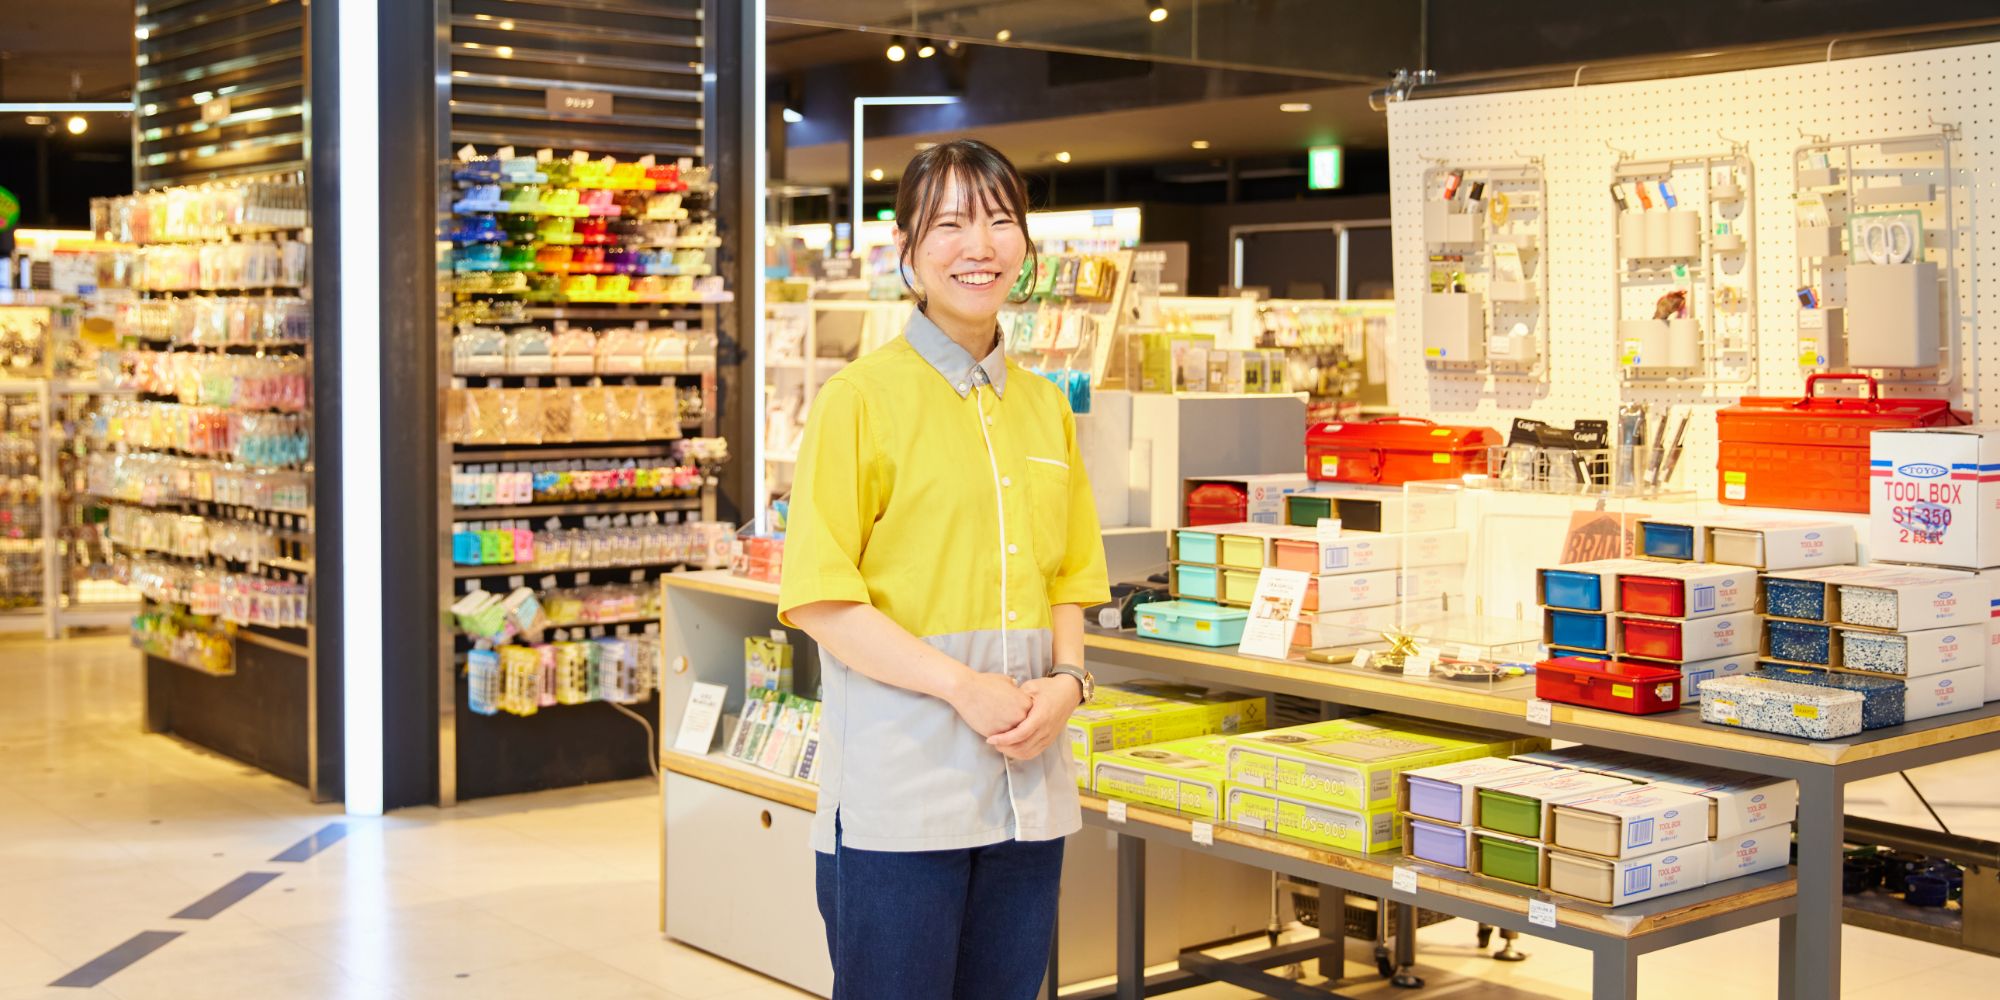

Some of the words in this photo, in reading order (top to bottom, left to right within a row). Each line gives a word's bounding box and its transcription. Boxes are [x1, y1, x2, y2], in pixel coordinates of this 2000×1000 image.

[1909, 467, 1939, 476] TOYO
[1884, 481, 1925, 502] TOOL
[1929, 483, 1962, 505] BOX
[1892, 506, 1952, 526] ST-350
[1301, 815, 1346, 838] KS-003
